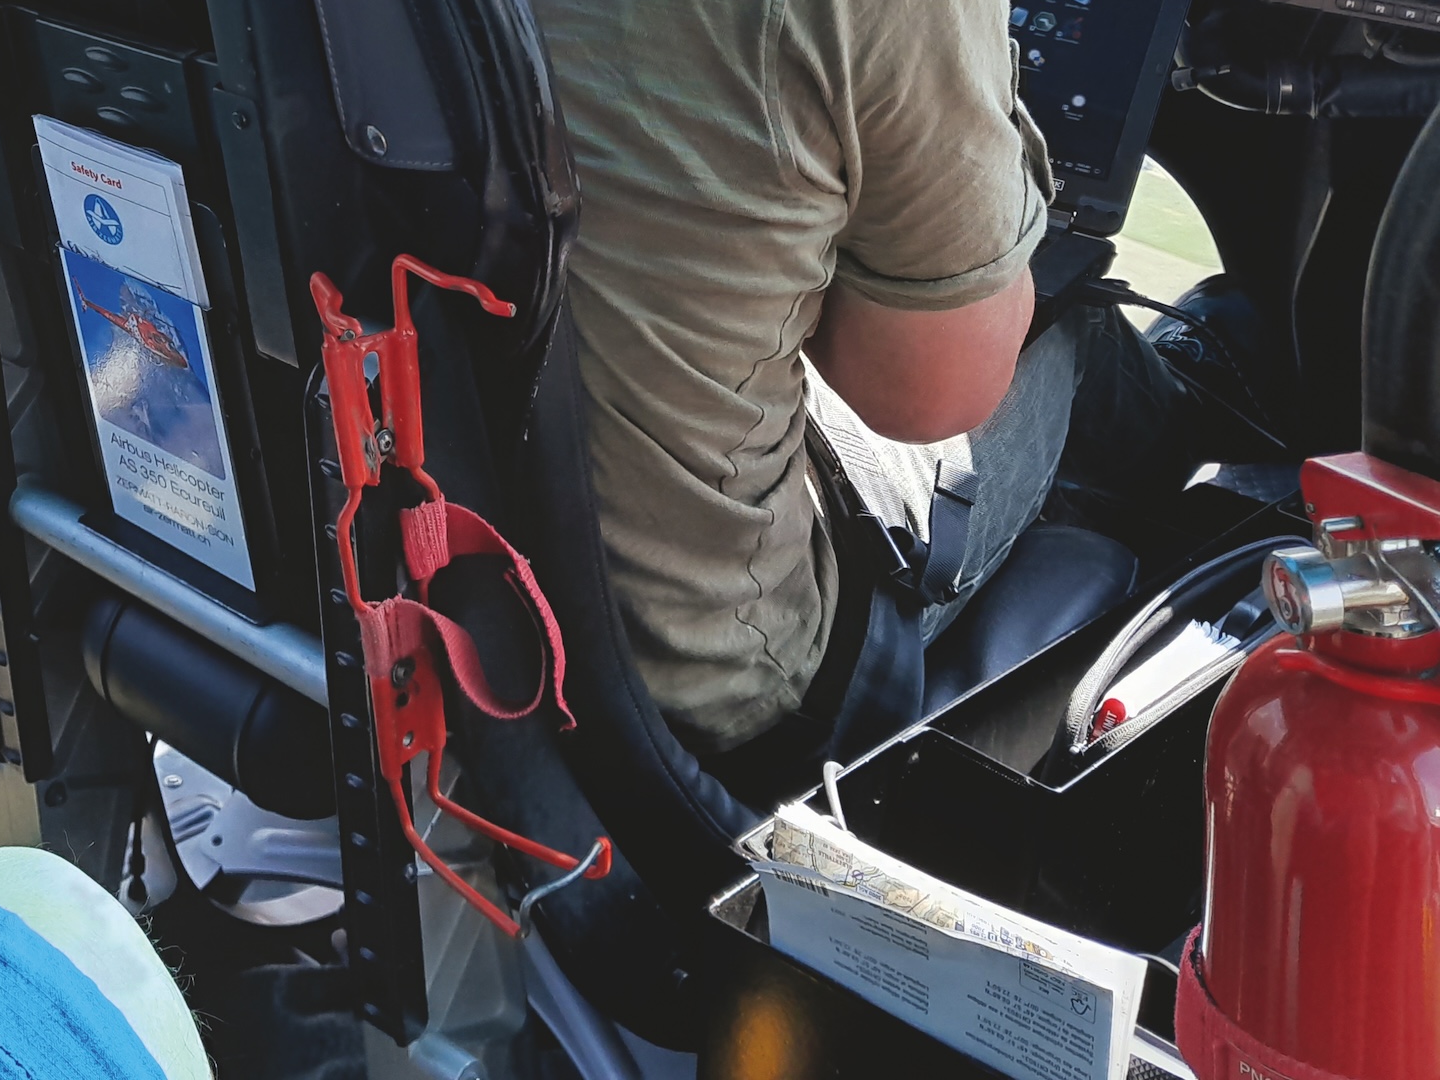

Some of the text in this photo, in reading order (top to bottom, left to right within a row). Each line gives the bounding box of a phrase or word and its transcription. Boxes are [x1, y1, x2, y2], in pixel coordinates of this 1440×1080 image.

[1375, 5, 1385, 13] P2
[71, 161, 122, 189] Safety Card
[111, 433, 225, 501] Airbus Helicopter
[119, 455, 226, 521] AS 350 Ecureuil
